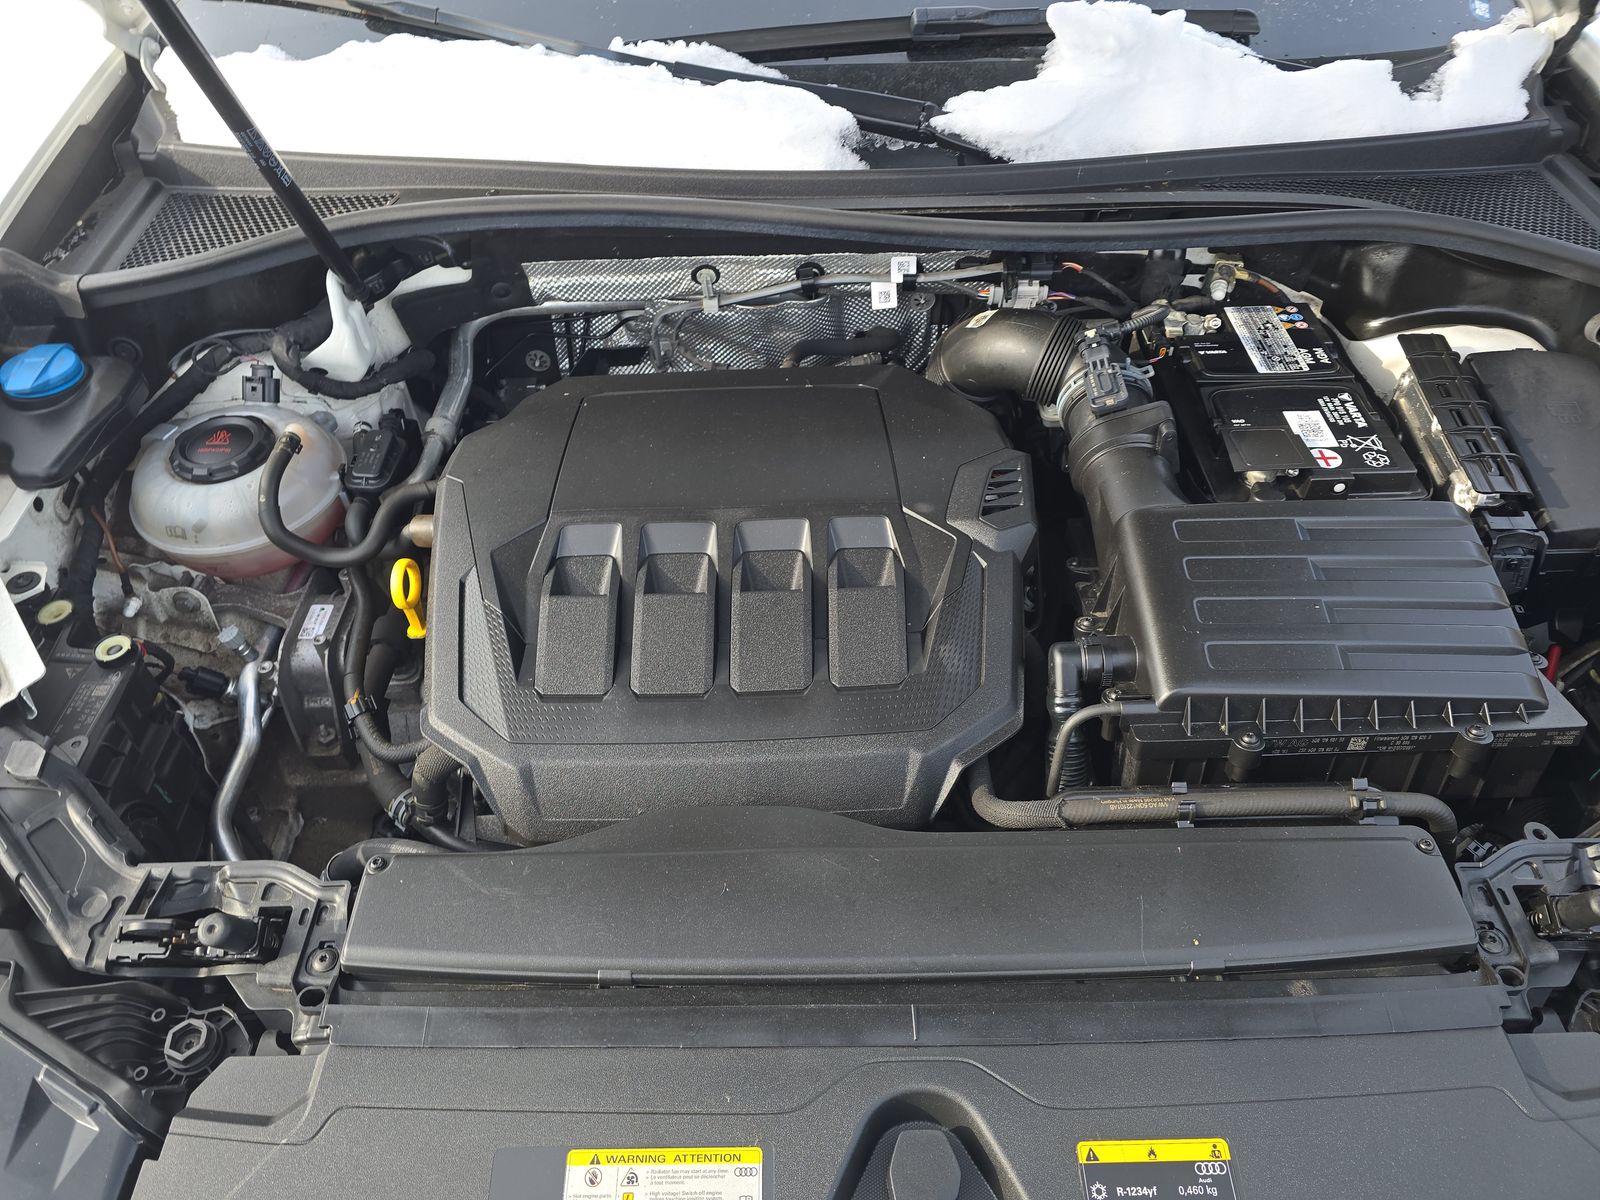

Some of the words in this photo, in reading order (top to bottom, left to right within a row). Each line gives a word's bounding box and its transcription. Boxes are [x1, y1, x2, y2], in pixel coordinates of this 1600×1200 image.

[1312, 348, 1332, 364] AGM
[1344, 402, 1368, 428] VARTA
[606, 1155, 666, 1164] WARNING
[673, 1153, 741, 1163] ATTENTION
[1116, 1186, 1157, 1198] R-1234yf
[1178, 1185, 1204, 1196] 0,460
[1206, 1185, 1218, 1196] kg
